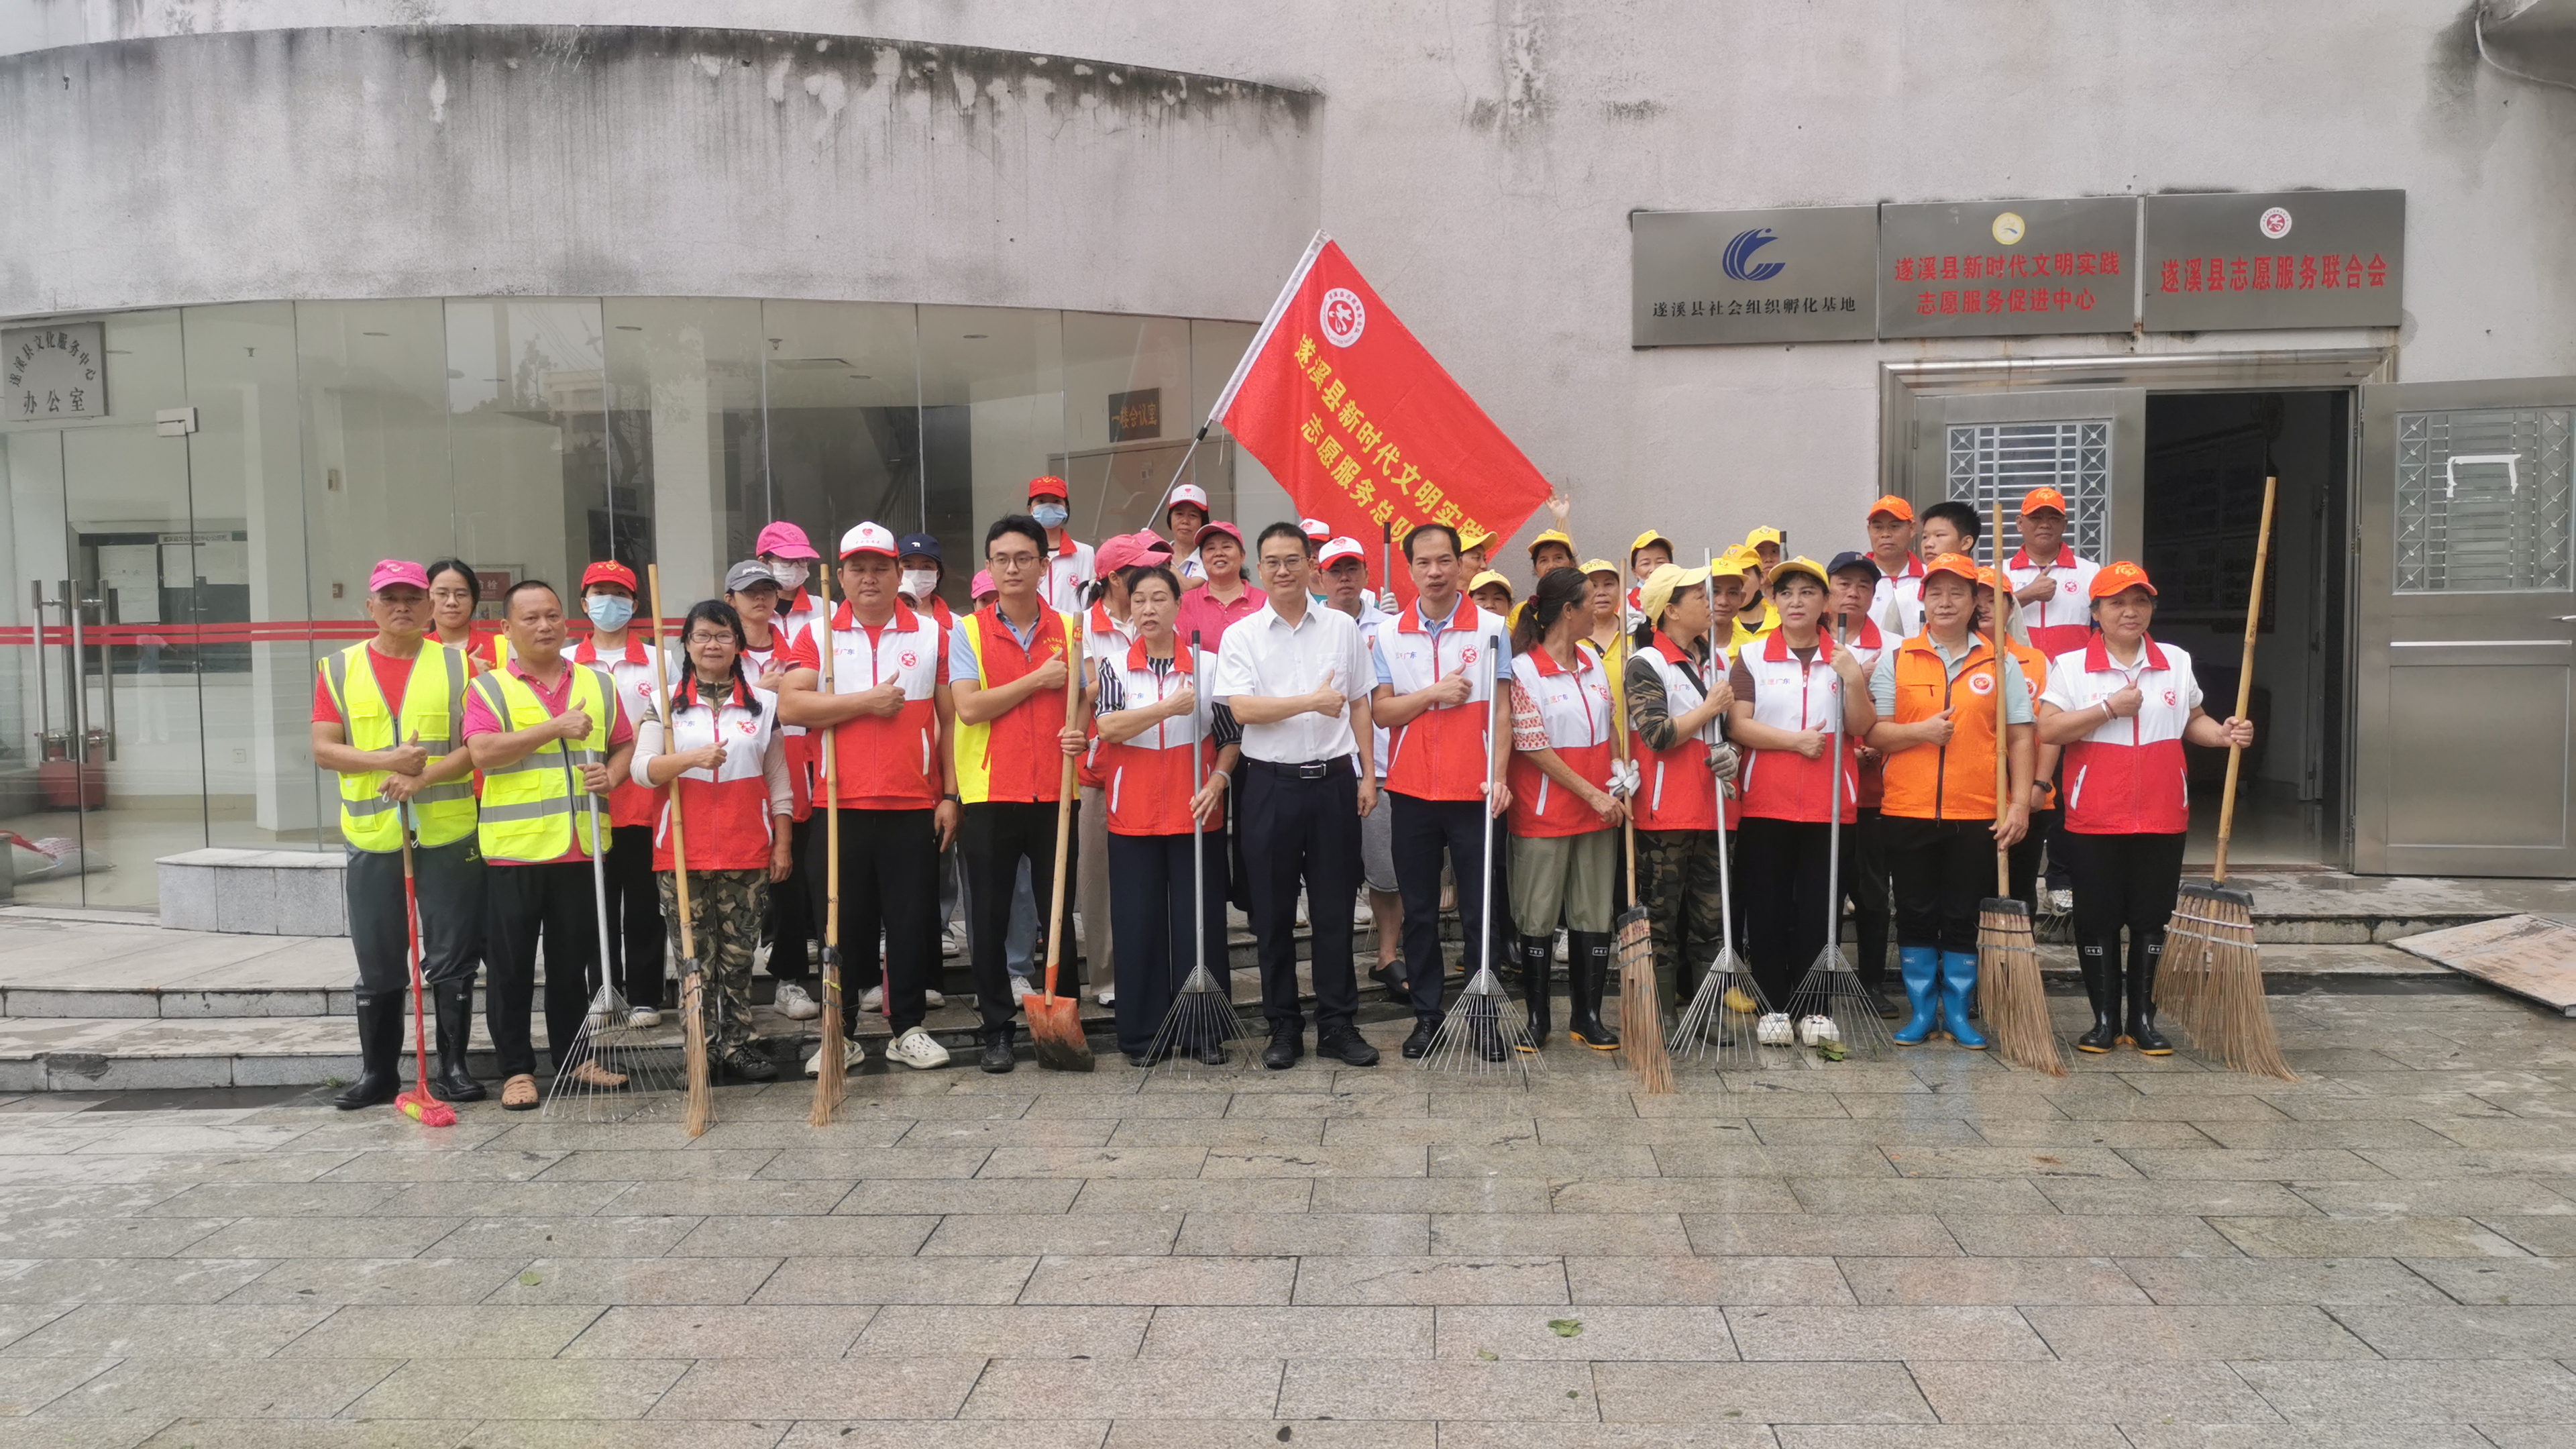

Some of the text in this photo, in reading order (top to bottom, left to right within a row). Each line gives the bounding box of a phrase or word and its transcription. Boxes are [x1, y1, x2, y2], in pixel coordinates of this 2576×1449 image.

[1894, 250, 2121, 282] 遂溪县新时代文明实践
[2160, 252, 2387, 293] 遂溪县志愿服务联合会
[1652, 295, 1856, 317] 遂溪县社会组织孵化基地
[1917, 286, 2096, 316] 志愿服务促进中心
[9, 331, 97, 387] 遂溪县文化服务中心
[23, 386, 85, 415] 办公室
[1111, 402, 1157, 430] 一楼会议室
[1293, 333, 1485, 539] 遂溪县新时代文明实践
[1300, 413, 1415, 551] 志愿服务总队
